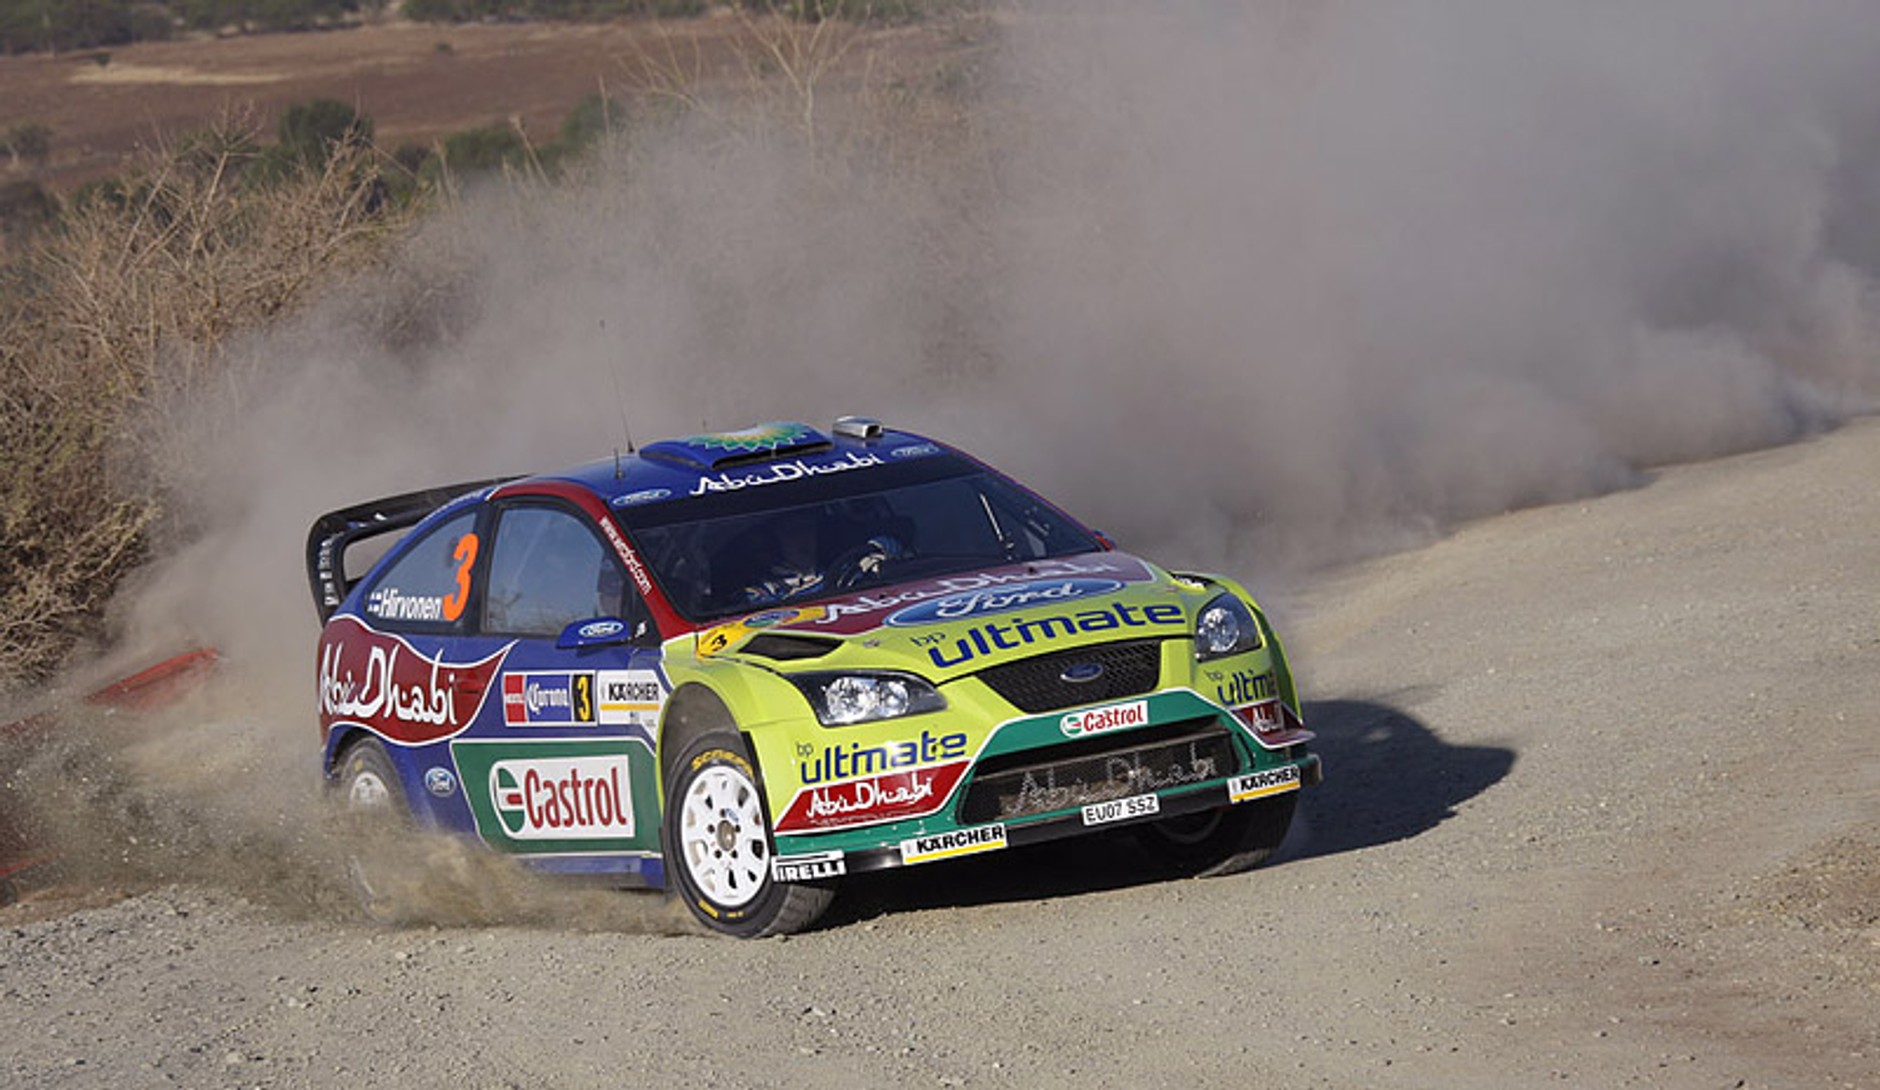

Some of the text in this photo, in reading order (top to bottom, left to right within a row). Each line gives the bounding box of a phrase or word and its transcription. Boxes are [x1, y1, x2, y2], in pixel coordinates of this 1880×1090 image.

[690, 452, 884, 496] Abu Dhabi
[442, 533, 479, 621] 3
[937, 582, 1084, 617] Ford
[378, 588, 442, 619] Hirvonen
[911, 631, 946, 648] bp
[929, 602, 1186, 669] ultimate
[354, 643, 458, 725] Dhabi
[577, 676, 591, 721] 3
[1083, 704, 1144, 732] Castrol
[801, 730, 967, 784] ultimate
[525, 766, 628, 829] Castrol
[806, 771, 933, 818] Abu Dhabi
[1085, 802, 1122, 822] EU07
